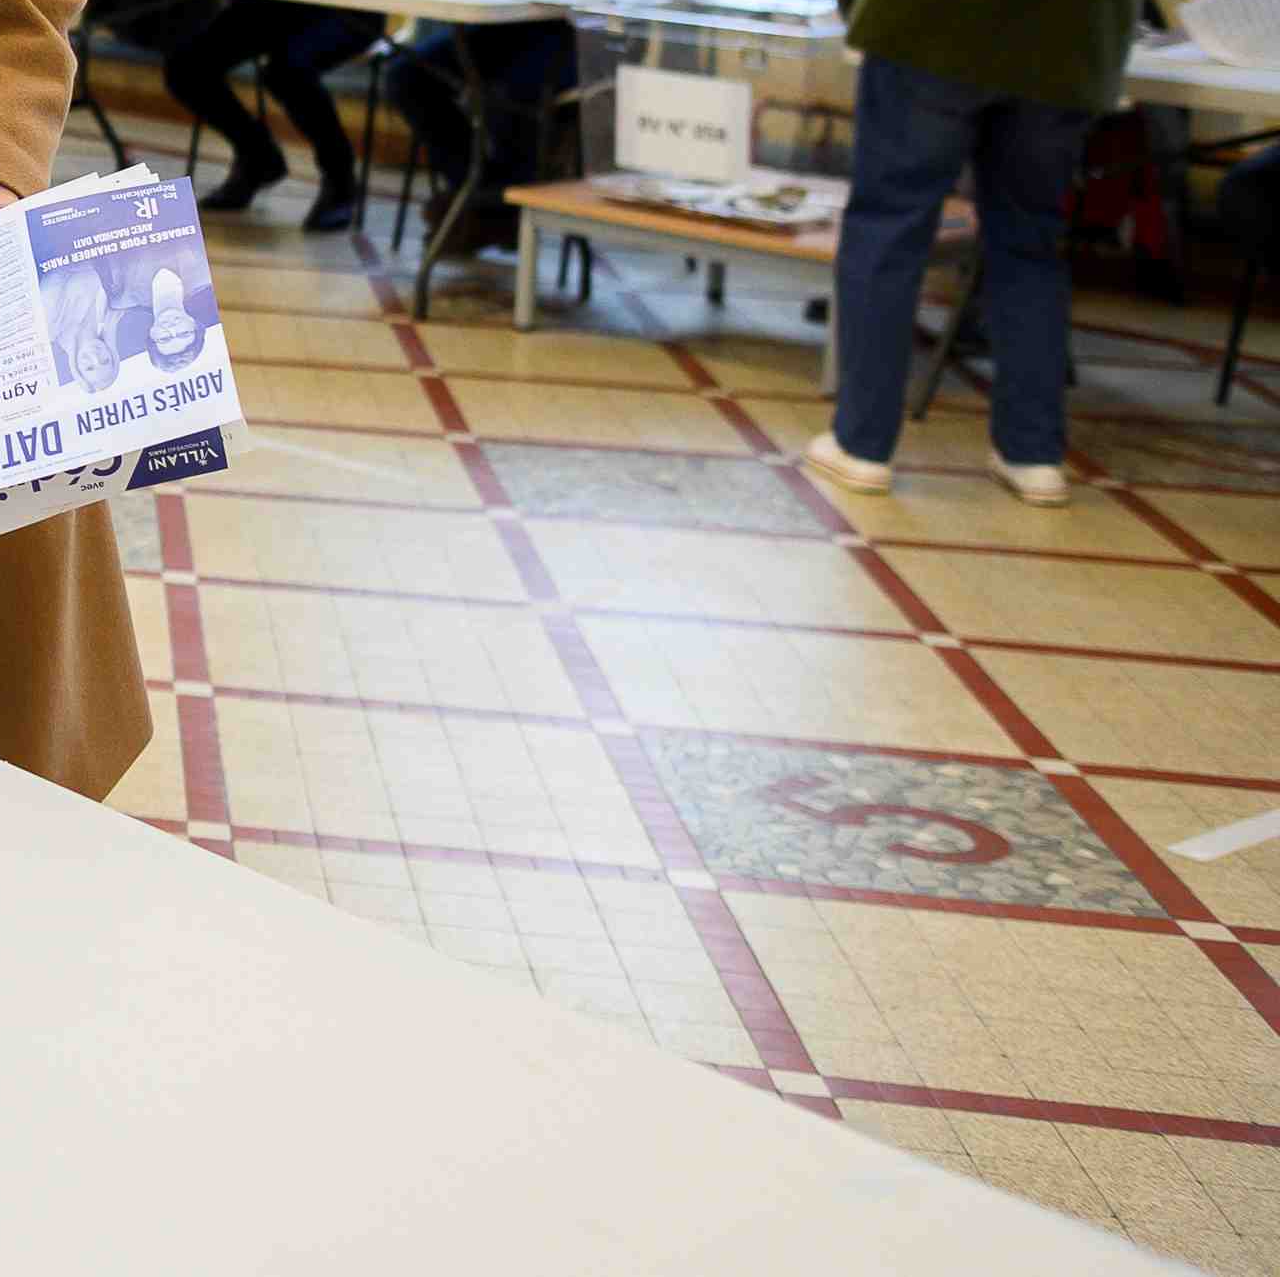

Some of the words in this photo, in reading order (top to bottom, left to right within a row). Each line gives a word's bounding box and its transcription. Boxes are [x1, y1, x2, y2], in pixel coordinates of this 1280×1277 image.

[93, 227, 130, 244] RACHIDA
[130, 223, 153, 235] AVEC
[149, 225, 197, 244] ENGAGÉS
[73, 234, 95, 249] DATI
[121, 234, 148, 251] POUR
[71, 241, 118, 263] CHANGER
[154, 368, 224, 411] AGNÈS
[77, 394, 147, 435] EVREN
[148, 447, 219, 471] VILLANI
[80, 481, 104, 492] avec
